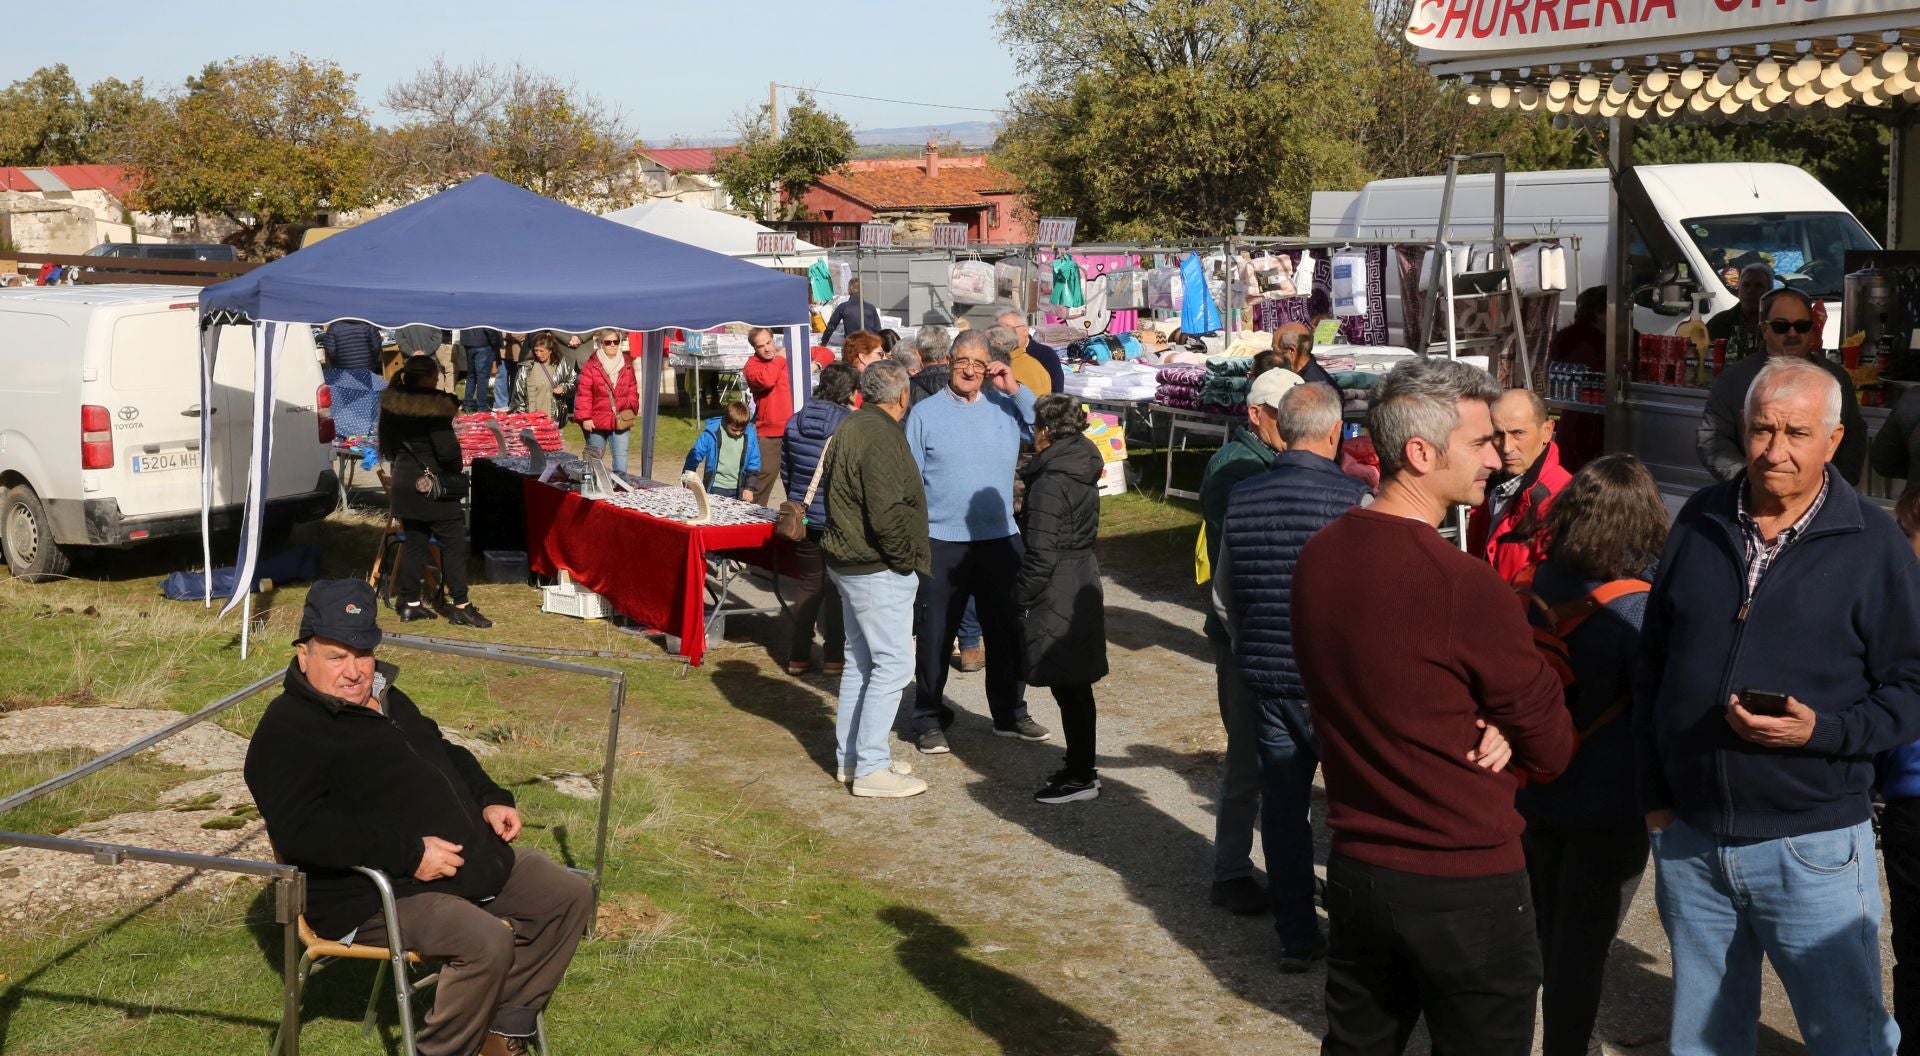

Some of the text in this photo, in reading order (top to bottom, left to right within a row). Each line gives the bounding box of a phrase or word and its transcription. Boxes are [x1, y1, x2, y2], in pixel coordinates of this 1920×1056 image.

[934, 226, 966, 246] OFERTAS
[1039, 220, 1075, 242] OFERTAS
[757, 234, 796, 253] OFERTAS
[114, 422, 144, 431] TOYOTA
[142, 452, 200, 470] 5204 MH
